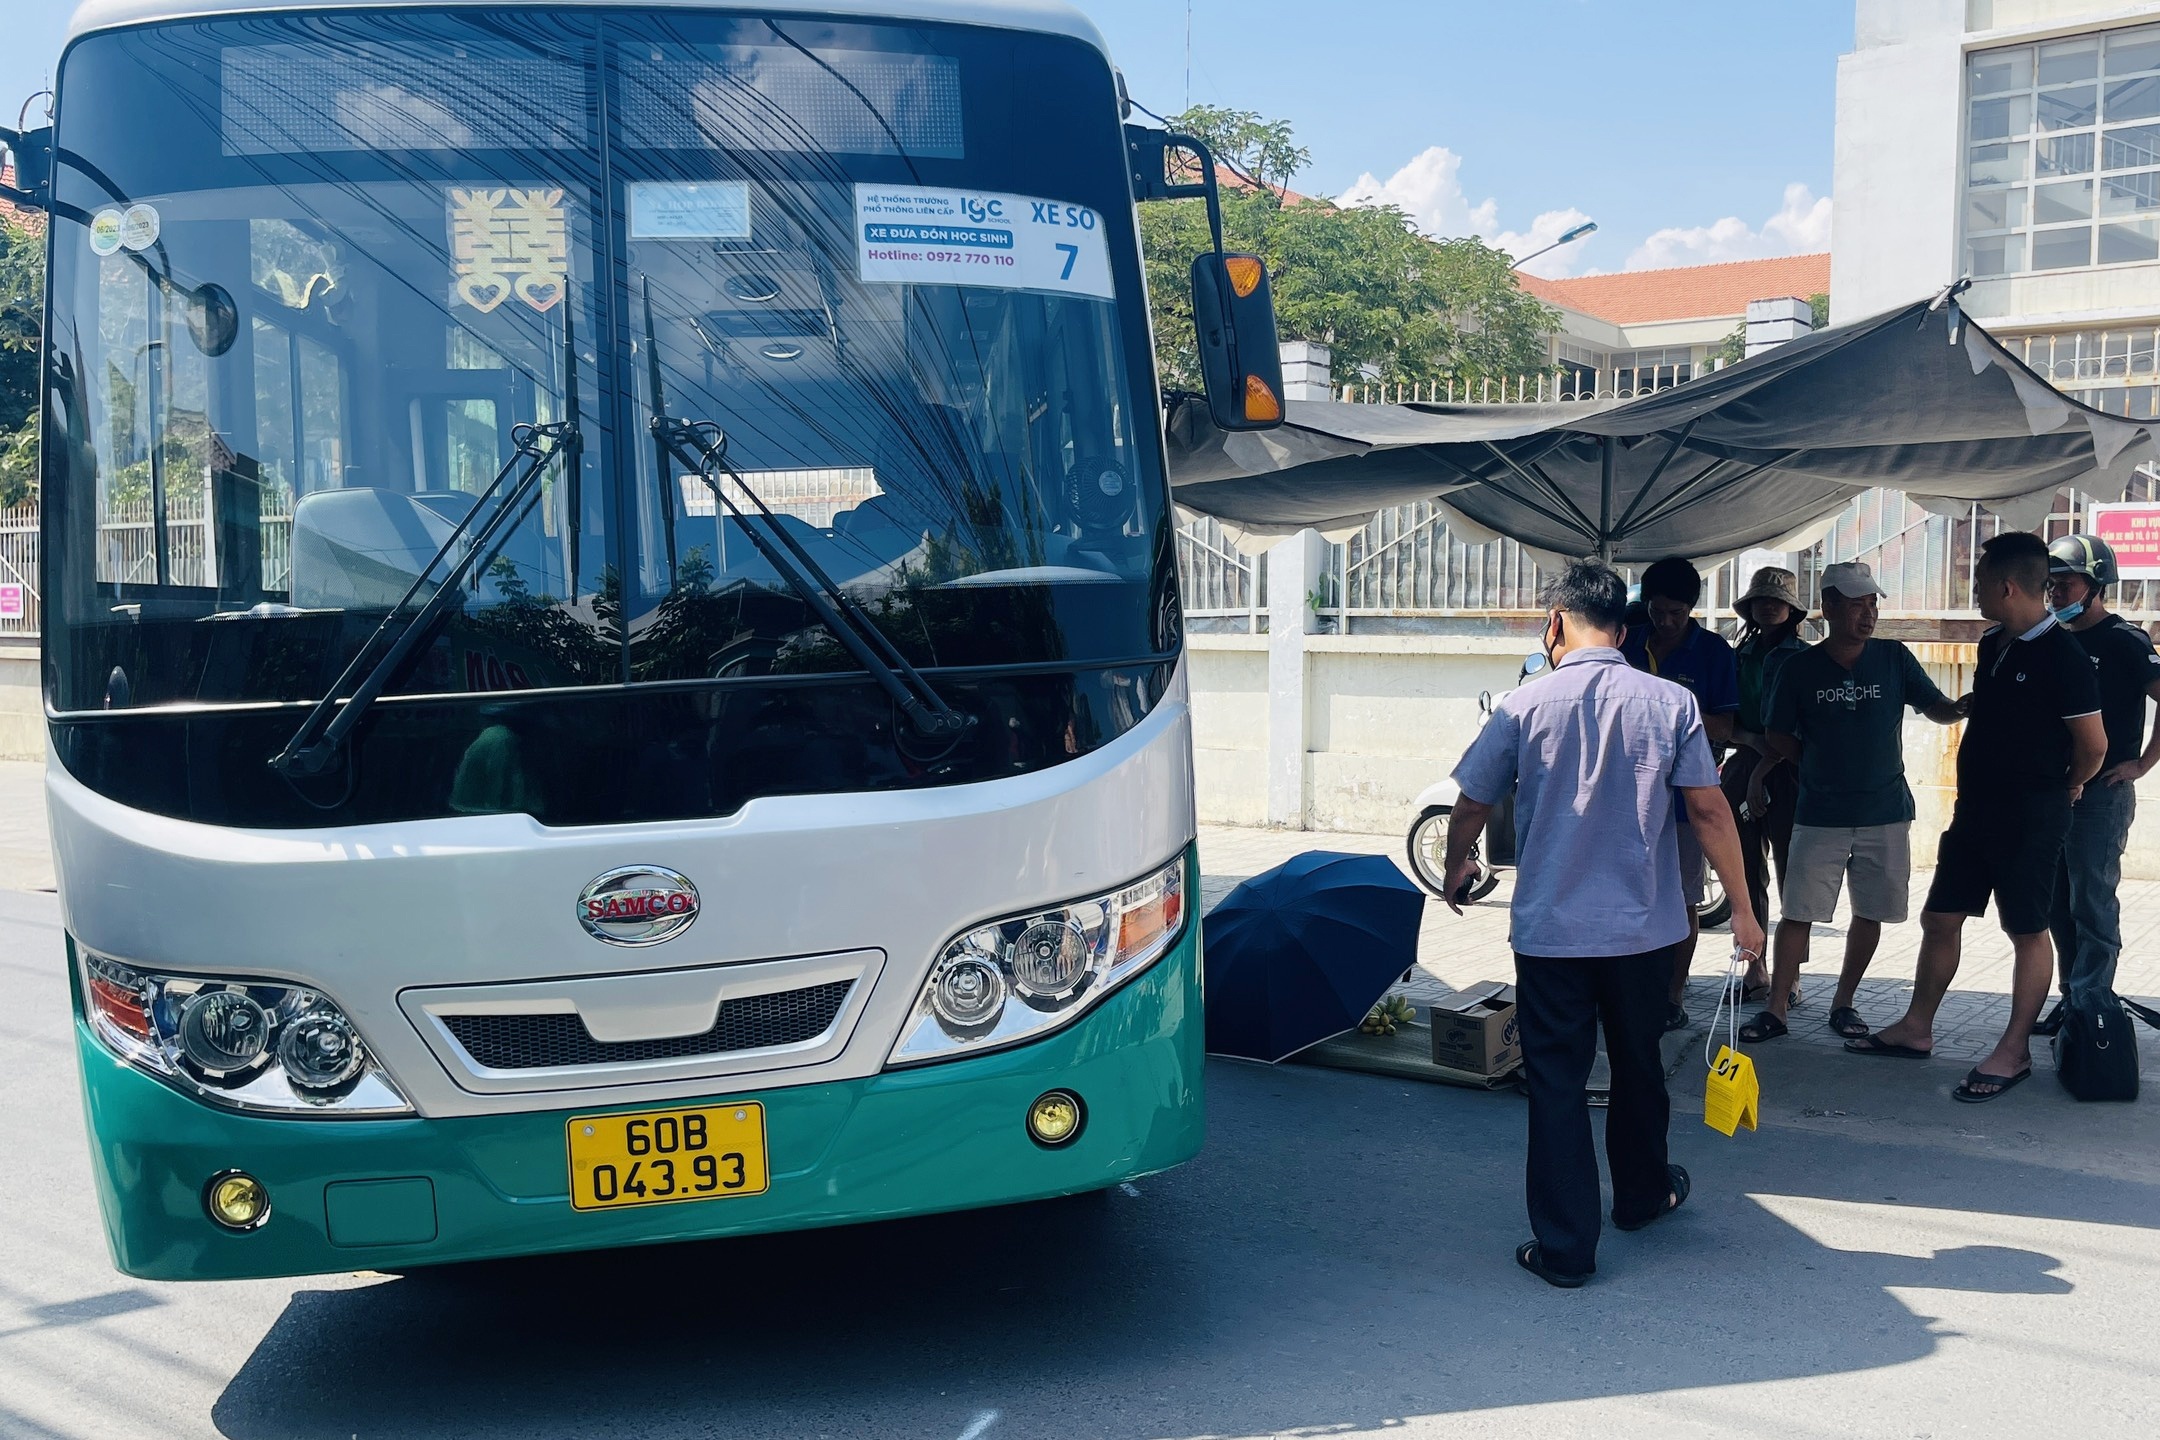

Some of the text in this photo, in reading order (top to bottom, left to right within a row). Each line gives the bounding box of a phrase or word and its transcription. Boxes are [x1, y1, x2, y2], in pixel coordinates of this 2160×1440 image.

[863, 203, 955, 216] PHỔ THÔNG LIÊN CẤP
[867, 193, 949, 206] HỆ THỐNG TRƯỜNG
[987, 217, 1012, 225] SCHOOL
[1030, 201, 1061, 226] XE
[870, 227, 1008, 244] XE ĐƯA ĐÓN HỌC SINH
[868, 249, 1014, 266] Hotline: 0972 770 110
[1055, 243, 1079, 281] 7
[2131, 517, 2146, 528] KHU
[1816, 684, 1881, 704] PORSCHE
[587, 893, 688, 919] SAMCO
[1717, 1058, 1740, 1081] 01
[626, 1114, 708, 1156] 60B
[593, 1152, 746, 1201] 043.93
